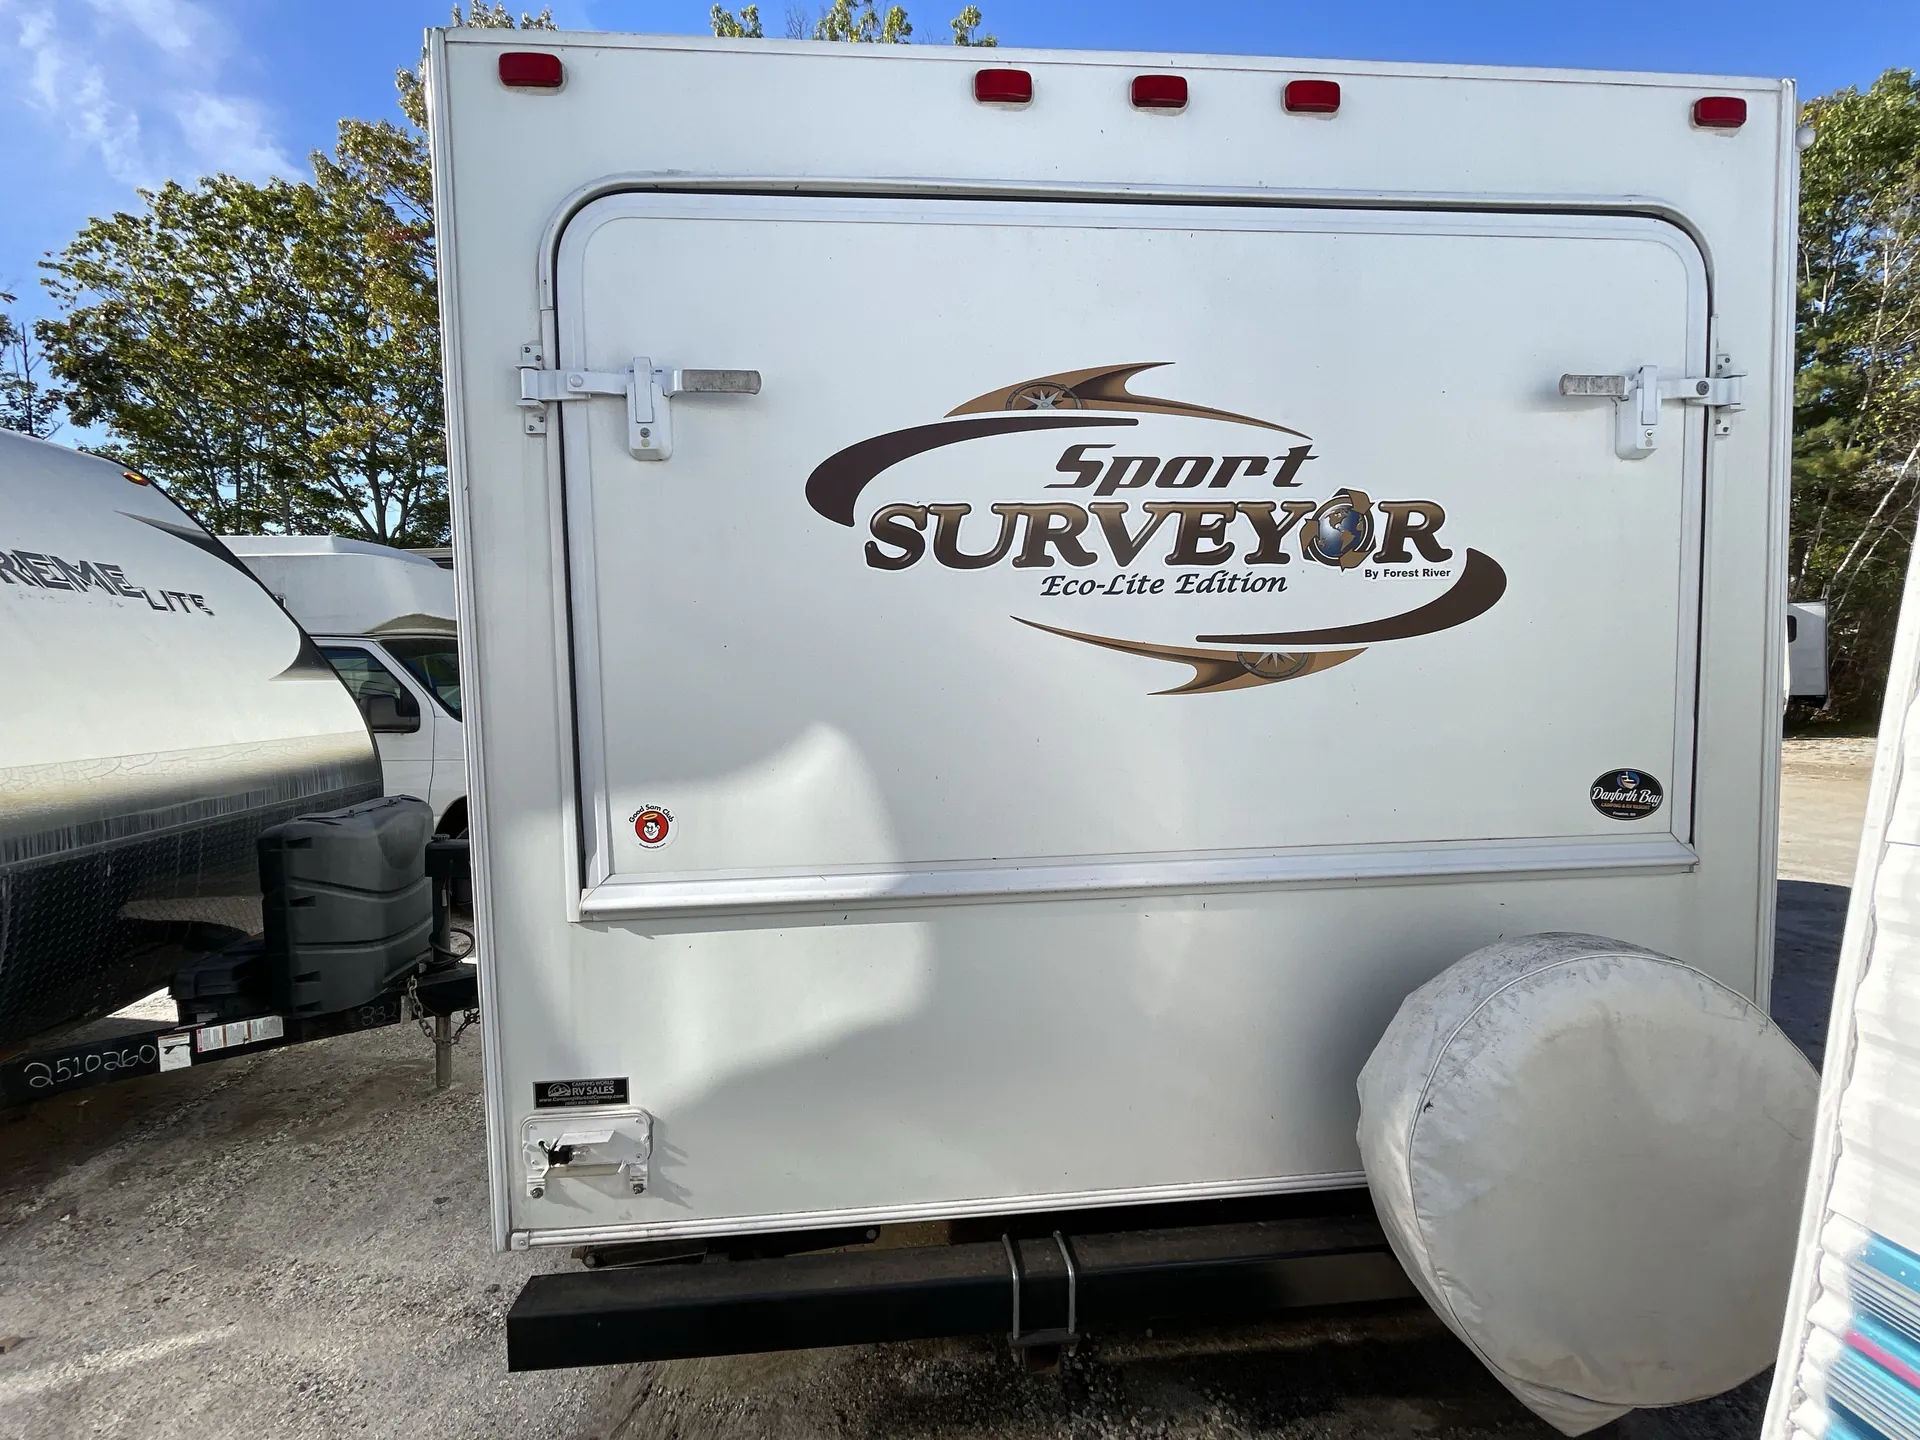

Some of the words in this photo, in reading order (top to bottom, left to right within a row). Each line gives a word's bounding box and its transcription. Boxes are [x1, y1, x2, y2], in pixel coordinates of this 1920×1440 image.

[1043, 443, 1319, 496] Sport
[864, 489, 1453, 571] SURVEYOR
[1040, 573, 1165, 596] Eco-Lite
[1175, 570, 1288, 594] Edition
[1364, 569, 1379, 580] By
[1383, 568, 1420, 578] Forest
[1422, 567, 1451, 577] River
[142, 589, 215, 616] LITE
[1592, 786, 1638, 803] Danforth
[1639, 789, 1662, 807] Bay
[628, 805, 645, 823] Good
[662, 808, 674, 822] Club
[24, 1044, 157, 1088] 2510260
[572, 1087, 585, 1096] RV
[586, 1085, 614, 1095] SALES
